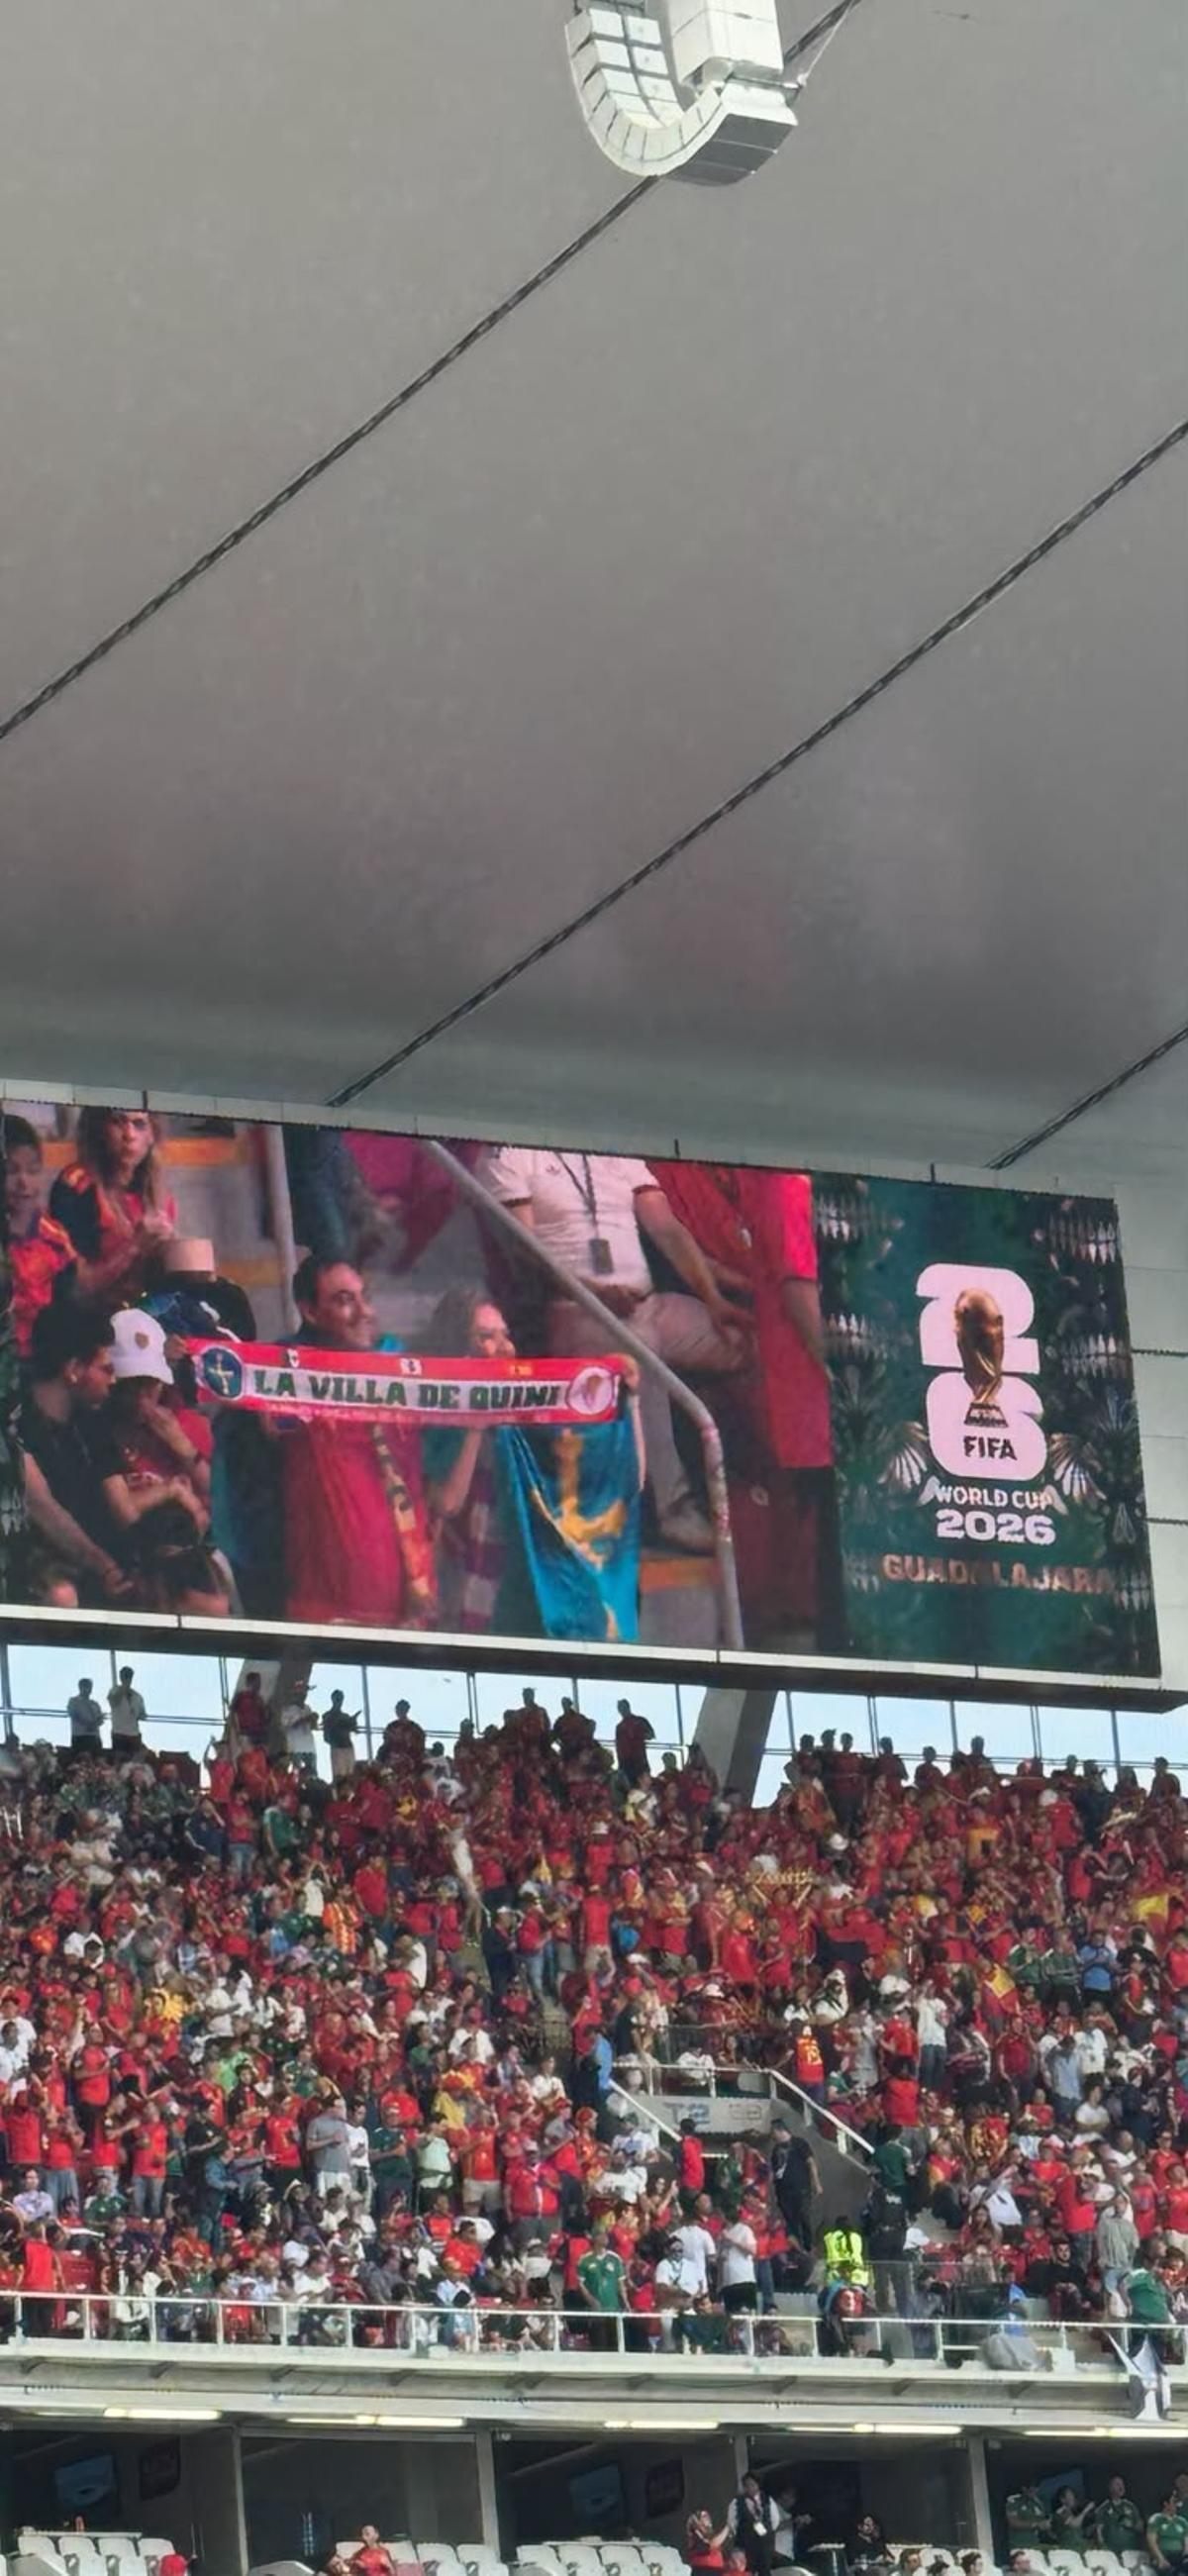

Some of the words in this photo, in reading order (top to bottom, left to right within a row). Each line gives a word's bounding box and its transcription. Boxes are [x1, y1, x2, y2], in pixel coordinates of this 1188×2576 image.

[253, 1370, 297, 1397] LA
[308, 1375, 408, 1407] VILLA
[418, 1383, 462, 1410] DE
[468, 1385, 560, 1411] QUINI
[962, 1436, 1018, 1460] FIFA
[934, 1485, 1009, 1508] WORLD
[1012, 1489, 1054, 1511] CUP
[936, 1508, 1056, 1545] 2026
[881, 1553, 1116, 1595] GUADLAJARA
